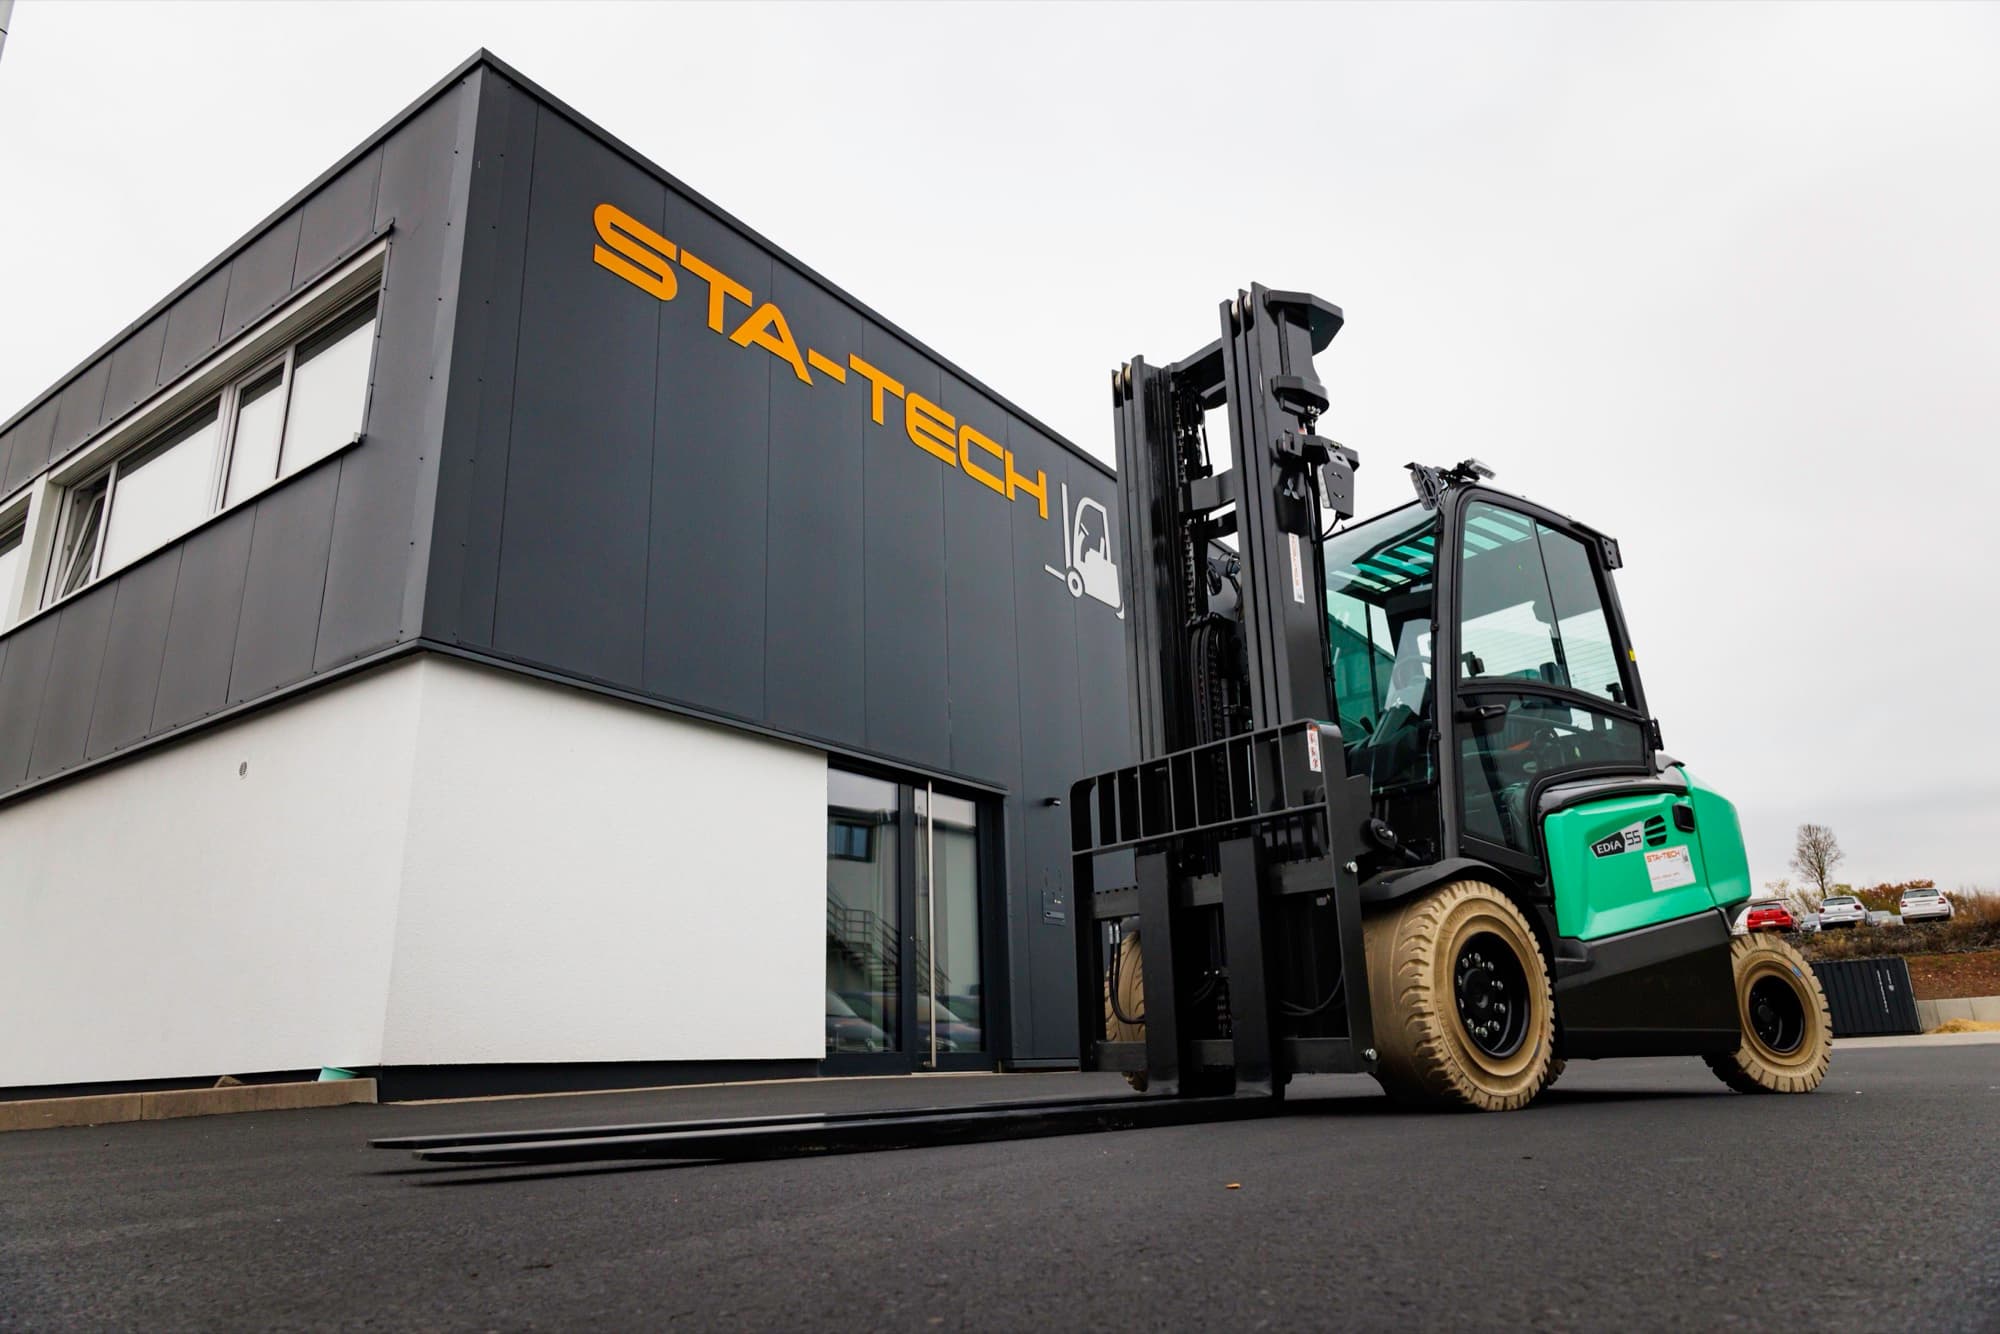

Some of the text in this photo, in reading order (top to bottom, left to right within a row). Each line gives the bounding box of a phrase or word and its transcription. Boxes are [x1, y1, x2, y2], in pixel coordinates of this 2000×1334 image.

[593, 203, 1049, 519] STA-TECH
[1597, 830, 1641, 854] EDIA 55
